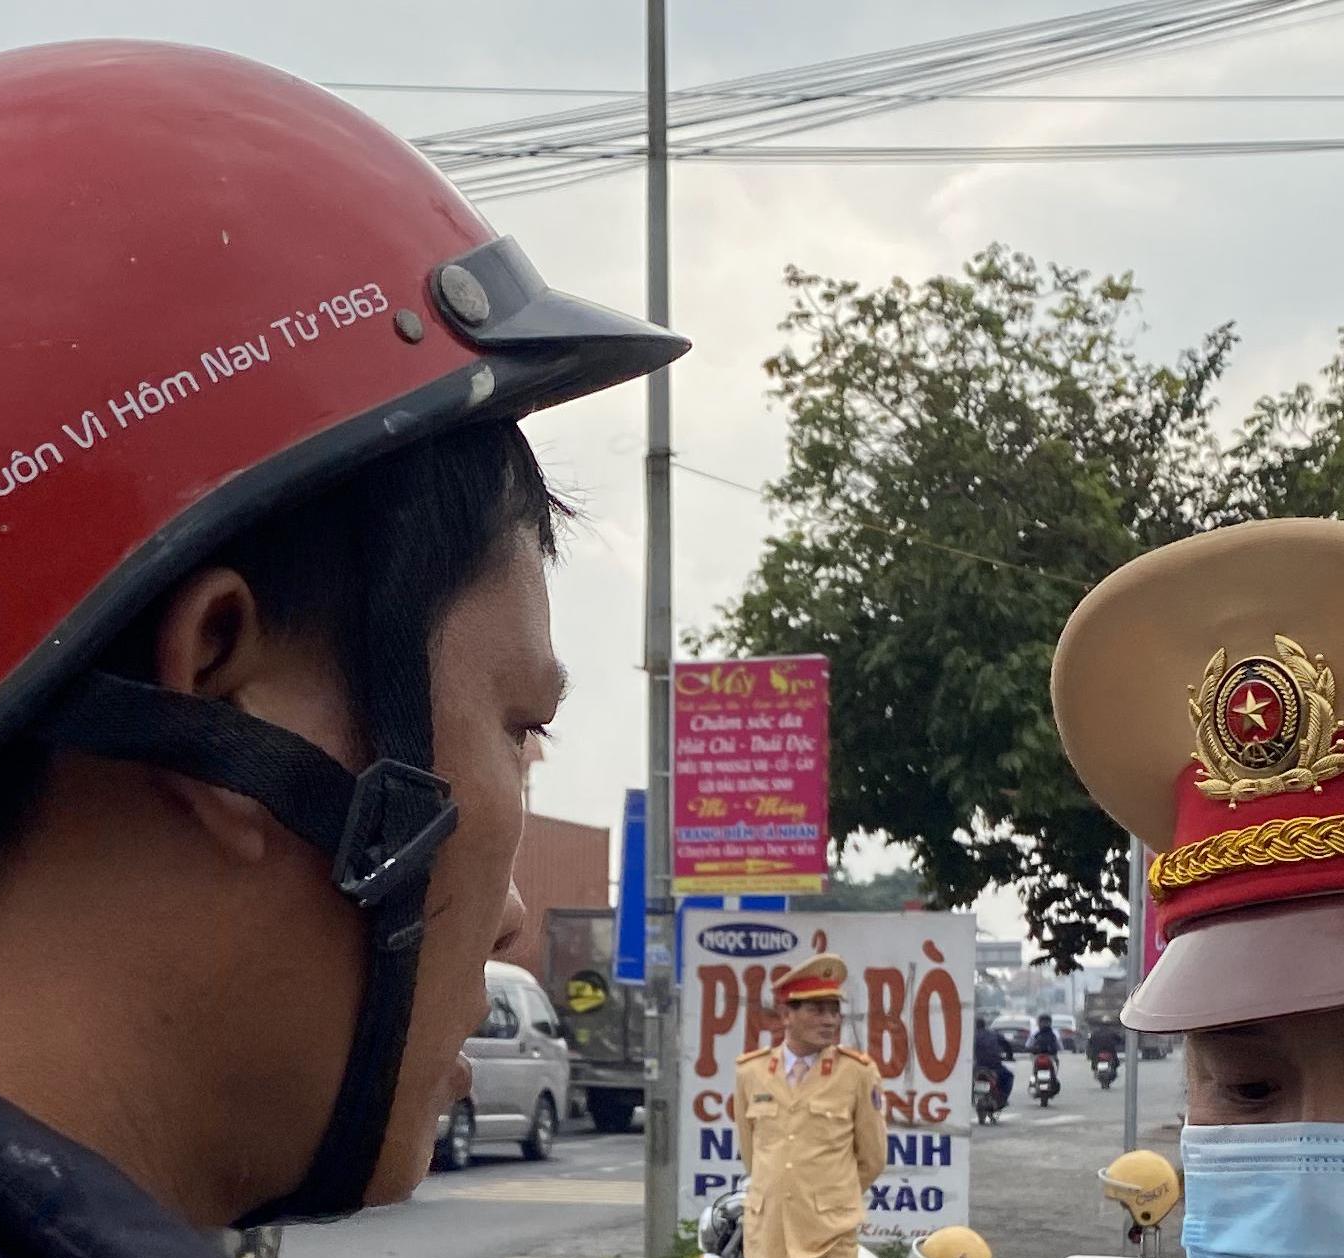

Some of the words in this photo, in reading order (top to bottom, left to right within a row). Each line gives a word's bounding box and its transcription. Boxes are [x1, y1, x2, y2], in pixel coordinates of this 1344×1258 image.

[62, 410, 109, 449] Vì
[108, 371, 201, 428] Hôm
[270, 310, 320, 348] Từ
[318, 282, 389, 329] 1963
[703, 930, 748, 952] NGỌC
[863, 938, 962, 1084] BÒ
[868, 1177, 945, 1212] XÀO
